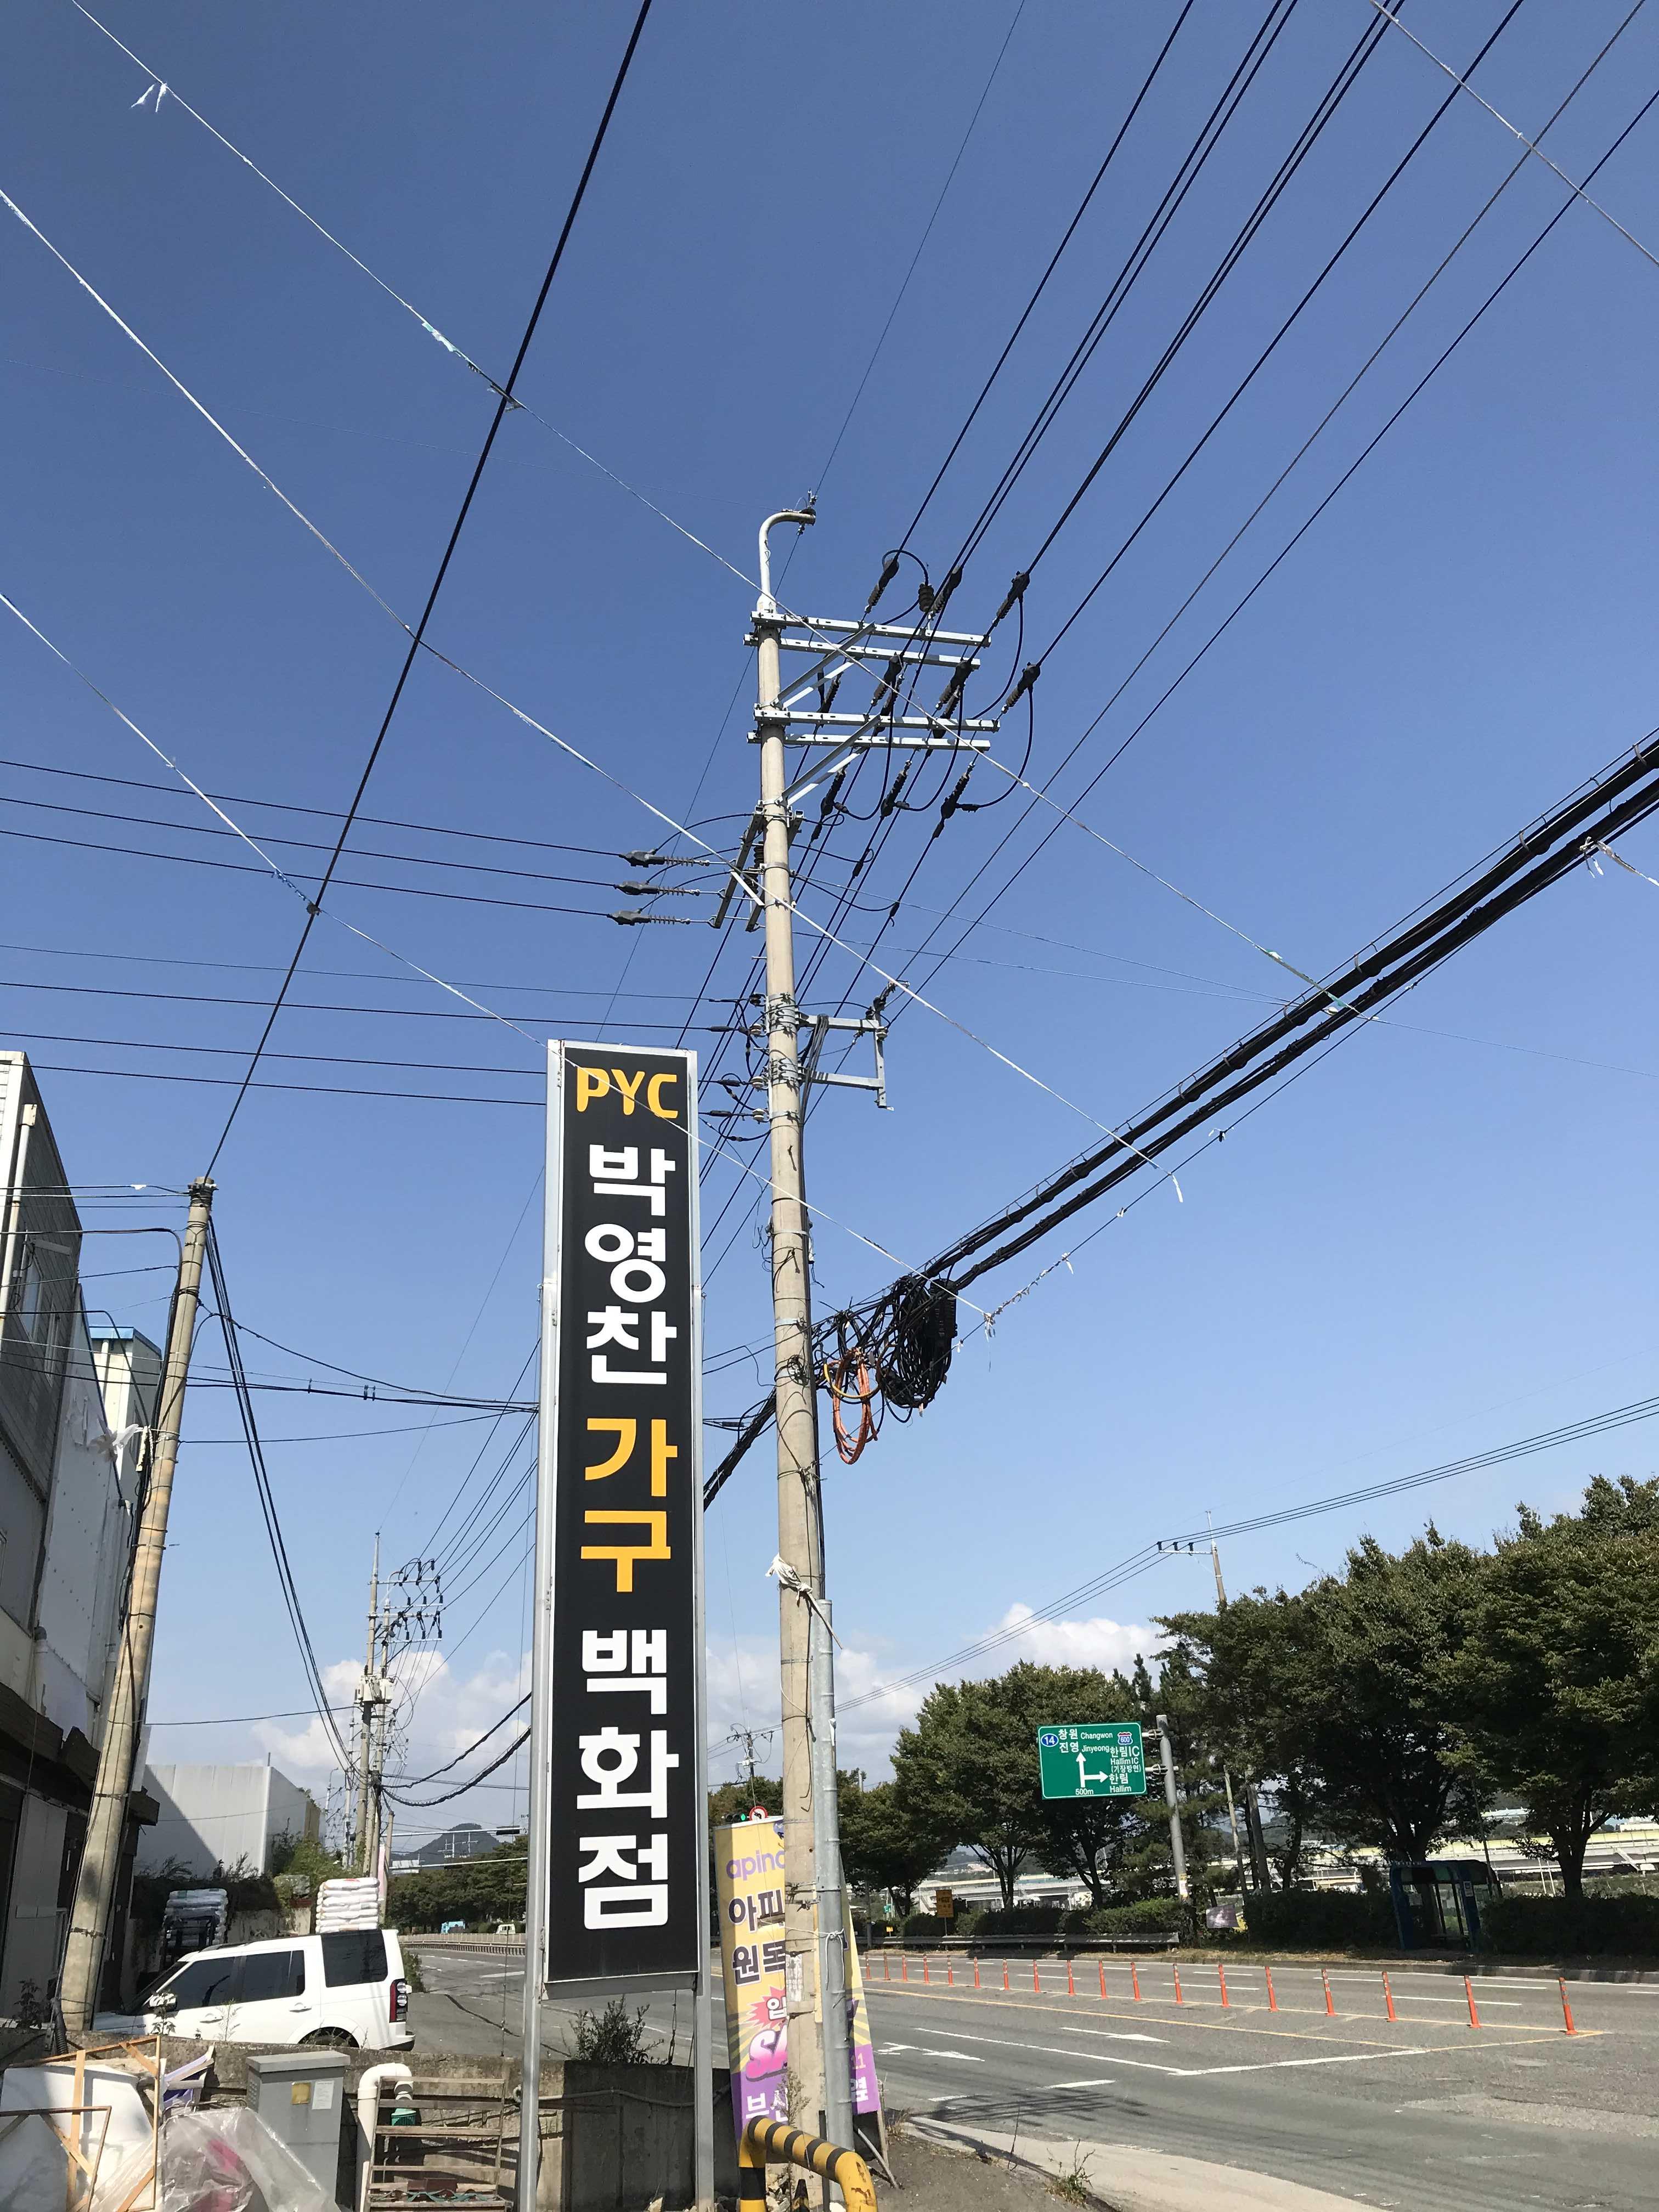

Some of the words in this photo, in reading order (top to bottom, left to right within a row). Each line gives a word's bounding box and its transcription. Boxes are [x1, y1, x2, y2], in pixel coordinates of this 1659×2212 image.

[577, 1067, 679, 1119] PYC
[584, 1144, 678, 1385] 박영찬
[580, 1418, 679, 1593] 가구
[1044, 1736, 1055, 1745] 14
[1058, 1729, 1078, 1740] 창원
[1080, 1732, 1113, 1741] Changwon
[1059, 1742, 1079, 1754] 진영
[1081, 1745, 1110, 1754] Jinyeong
[576, 1629, 680, 1931] 백화점
[1108, 1773, 1128, 1785] 한림
[1109, 1785, 1132, 1793] Hallim
